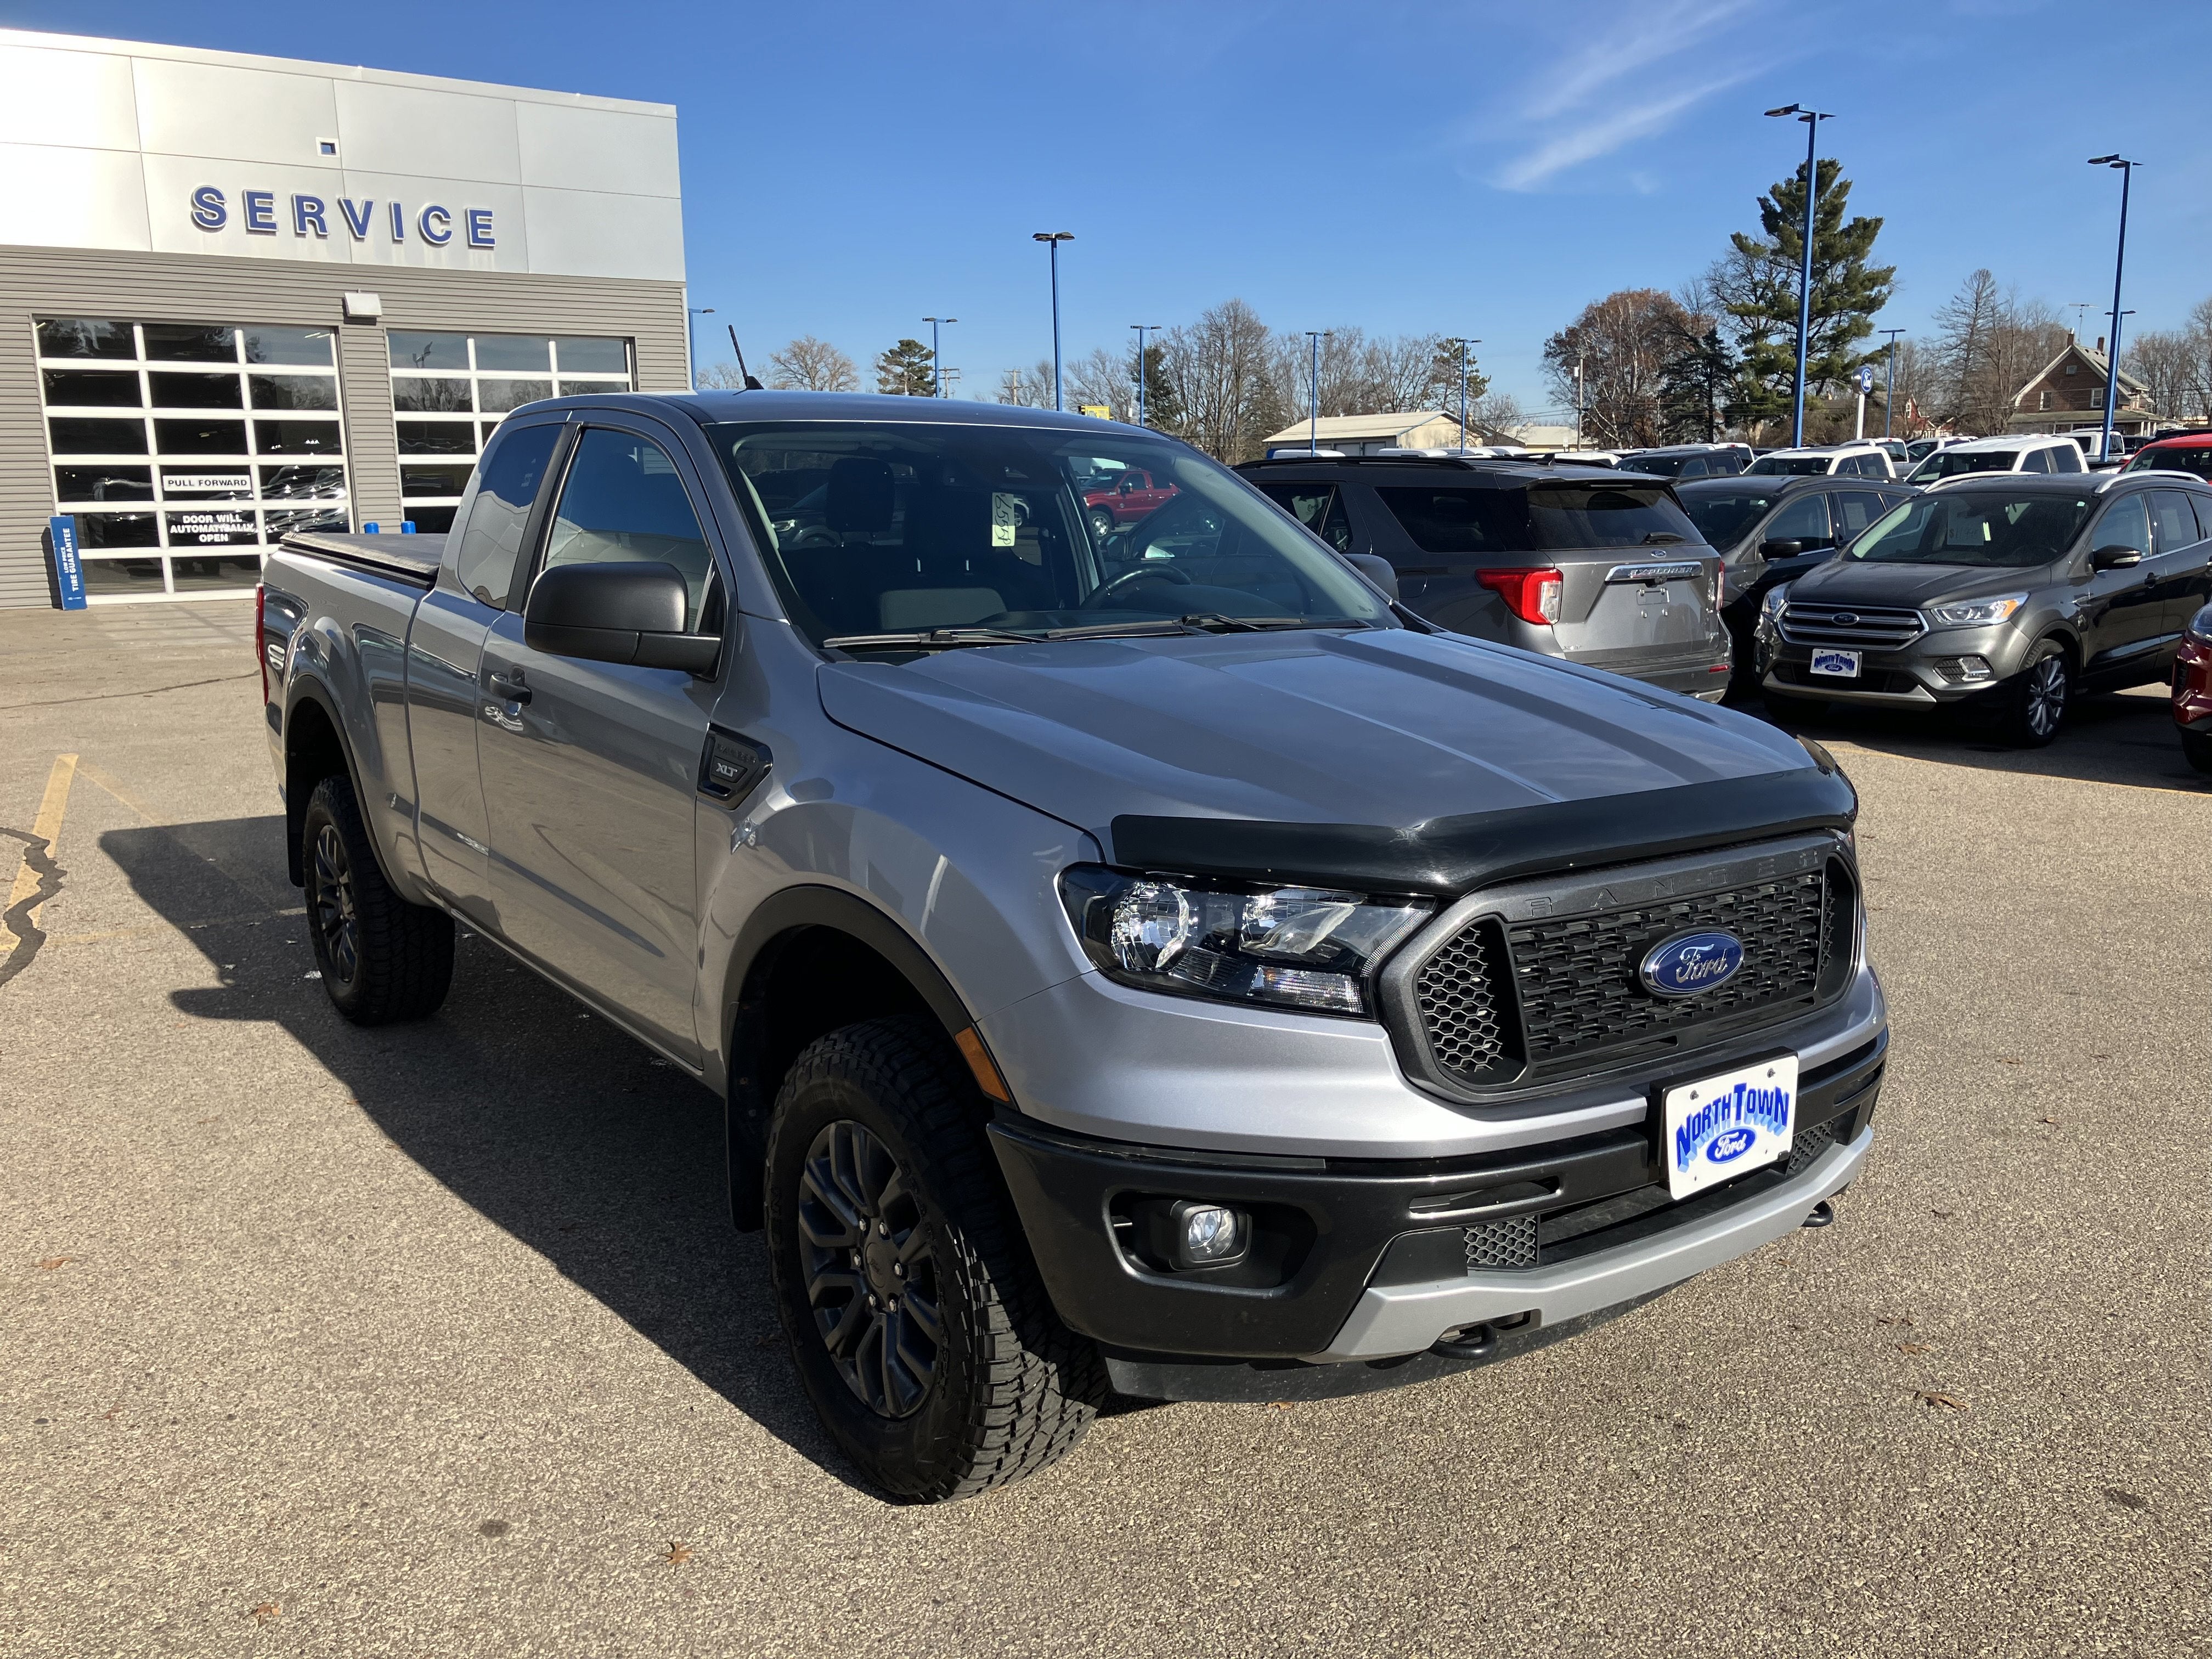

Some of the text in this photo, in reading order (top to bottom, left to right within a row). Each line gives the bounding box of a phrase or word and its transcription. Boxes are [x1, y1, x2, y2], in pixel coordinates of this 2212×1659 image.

[192, 185, 496, 247] SERVICE
[183, 514, 242, 524] DOOR WILL
[199, 533, 229, 543] OPEN
[63, 527, 76, 573] GUARANTEE
[1630, 567, 1693, 576] EXPLORER
[70, 574, 79, 592] TIRE
[716, 762, 738, 777] XLT
[1676, 943, 1728, 983] Ford
[1714, 1131, 1747, 1159] Ford
